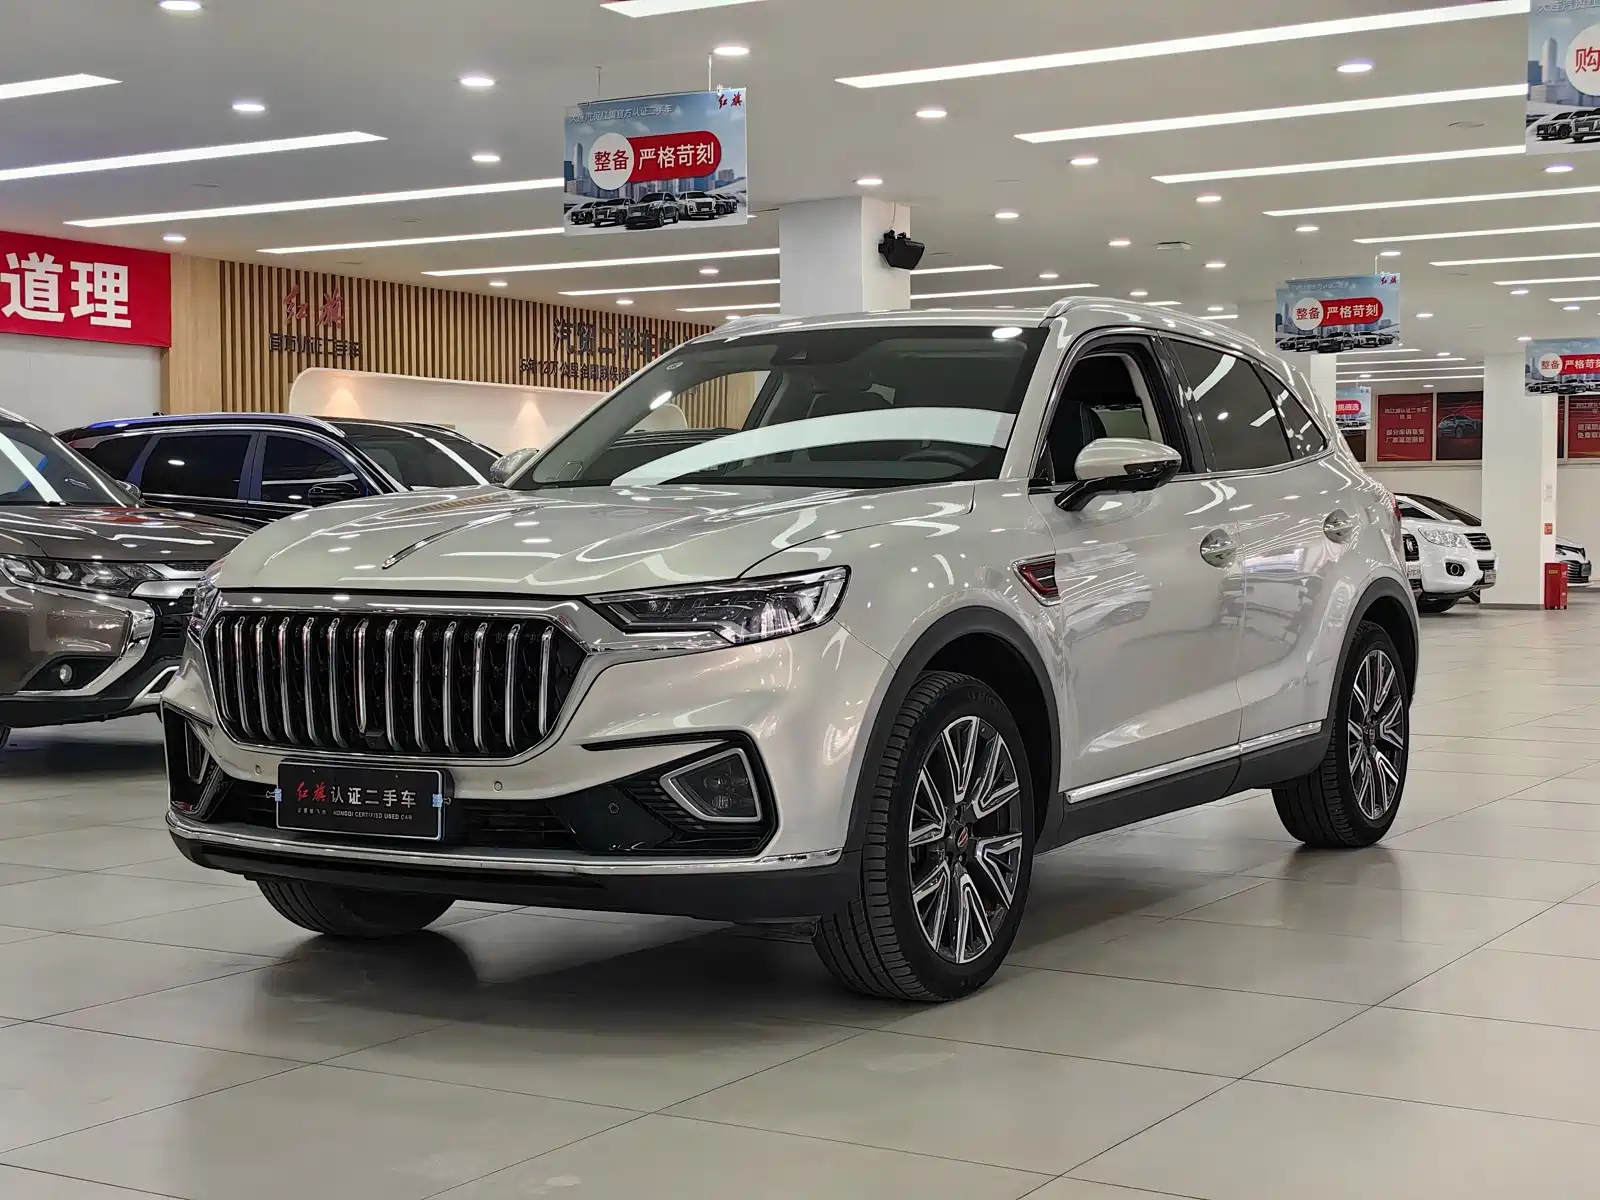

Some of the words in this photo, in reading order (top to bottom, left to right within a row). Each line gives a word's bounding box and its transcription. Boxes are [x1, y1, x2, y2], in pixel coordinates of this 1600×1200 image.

[594, 149, 630, 172] 整备
[638, 141, 715, 170] 严格苛刻
[0, 251, 132, 329] 道理
[1296, 307, 1320, 321] 整备
[1326, 303, 1379, 320] 严格苛刻
[333, 809, 354, 817] HONGQI
[355, 811, 383, 819] CERTIFIED
